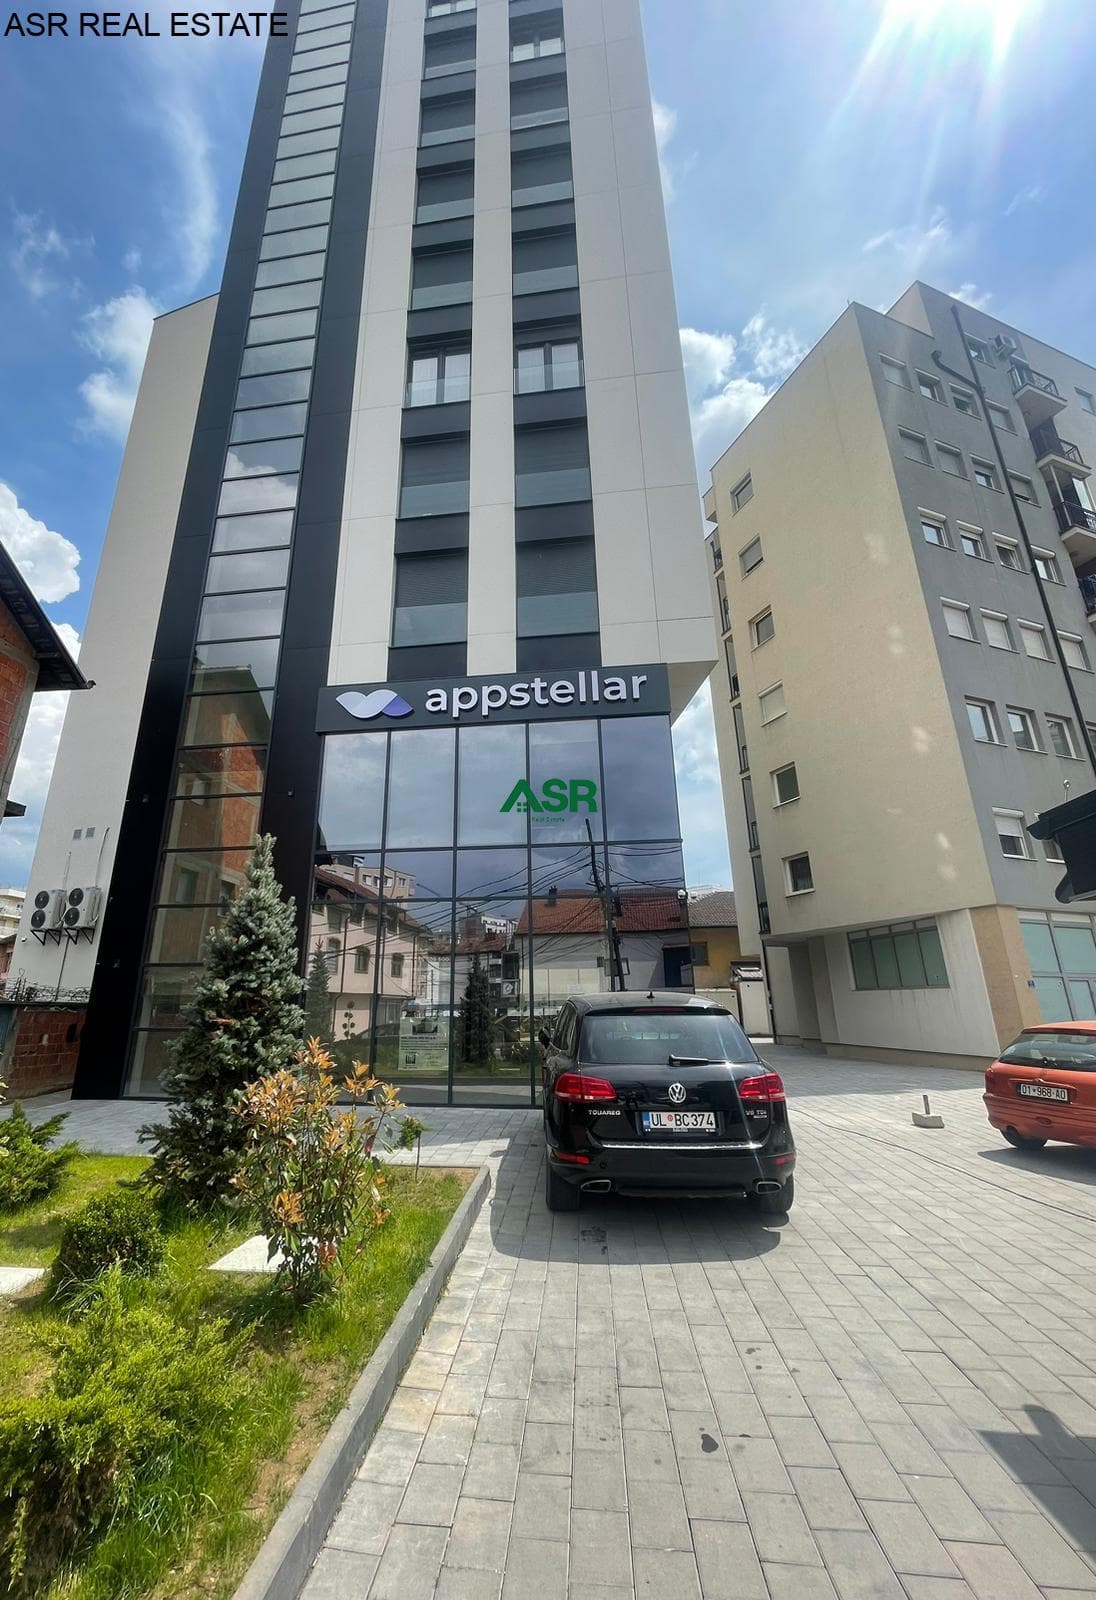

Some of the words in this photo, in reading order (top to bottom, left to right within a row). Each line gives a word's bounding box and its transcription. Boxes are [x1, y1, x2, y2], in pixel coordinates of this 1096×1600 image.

[425, 670, 648, 719] appstellar
[651, 1114, 667, 1127] UL
[674, 1113, 714, 1127] BC374
